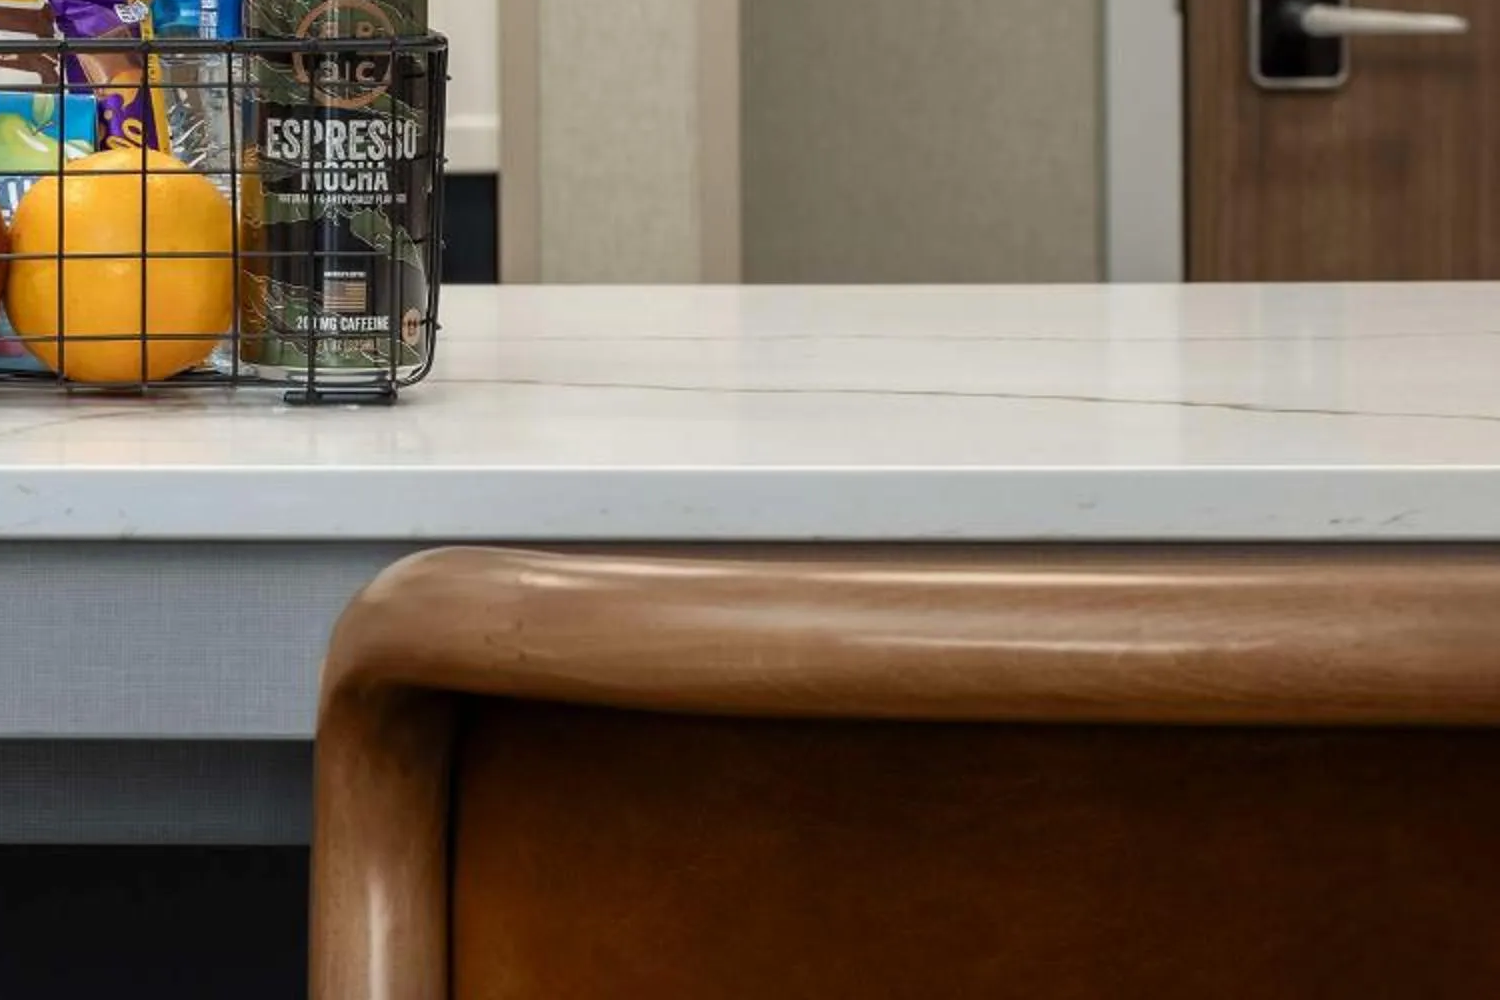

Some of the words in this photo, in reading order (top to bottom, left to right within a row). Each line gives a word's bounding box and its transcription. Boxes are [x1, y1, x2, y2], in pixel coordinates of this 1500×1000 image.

[267, 118, 417, 160] ESPRESSO
[301, 161, 389, 191] MOCHA
[341, 315, 390, 331] CAFFEINE
